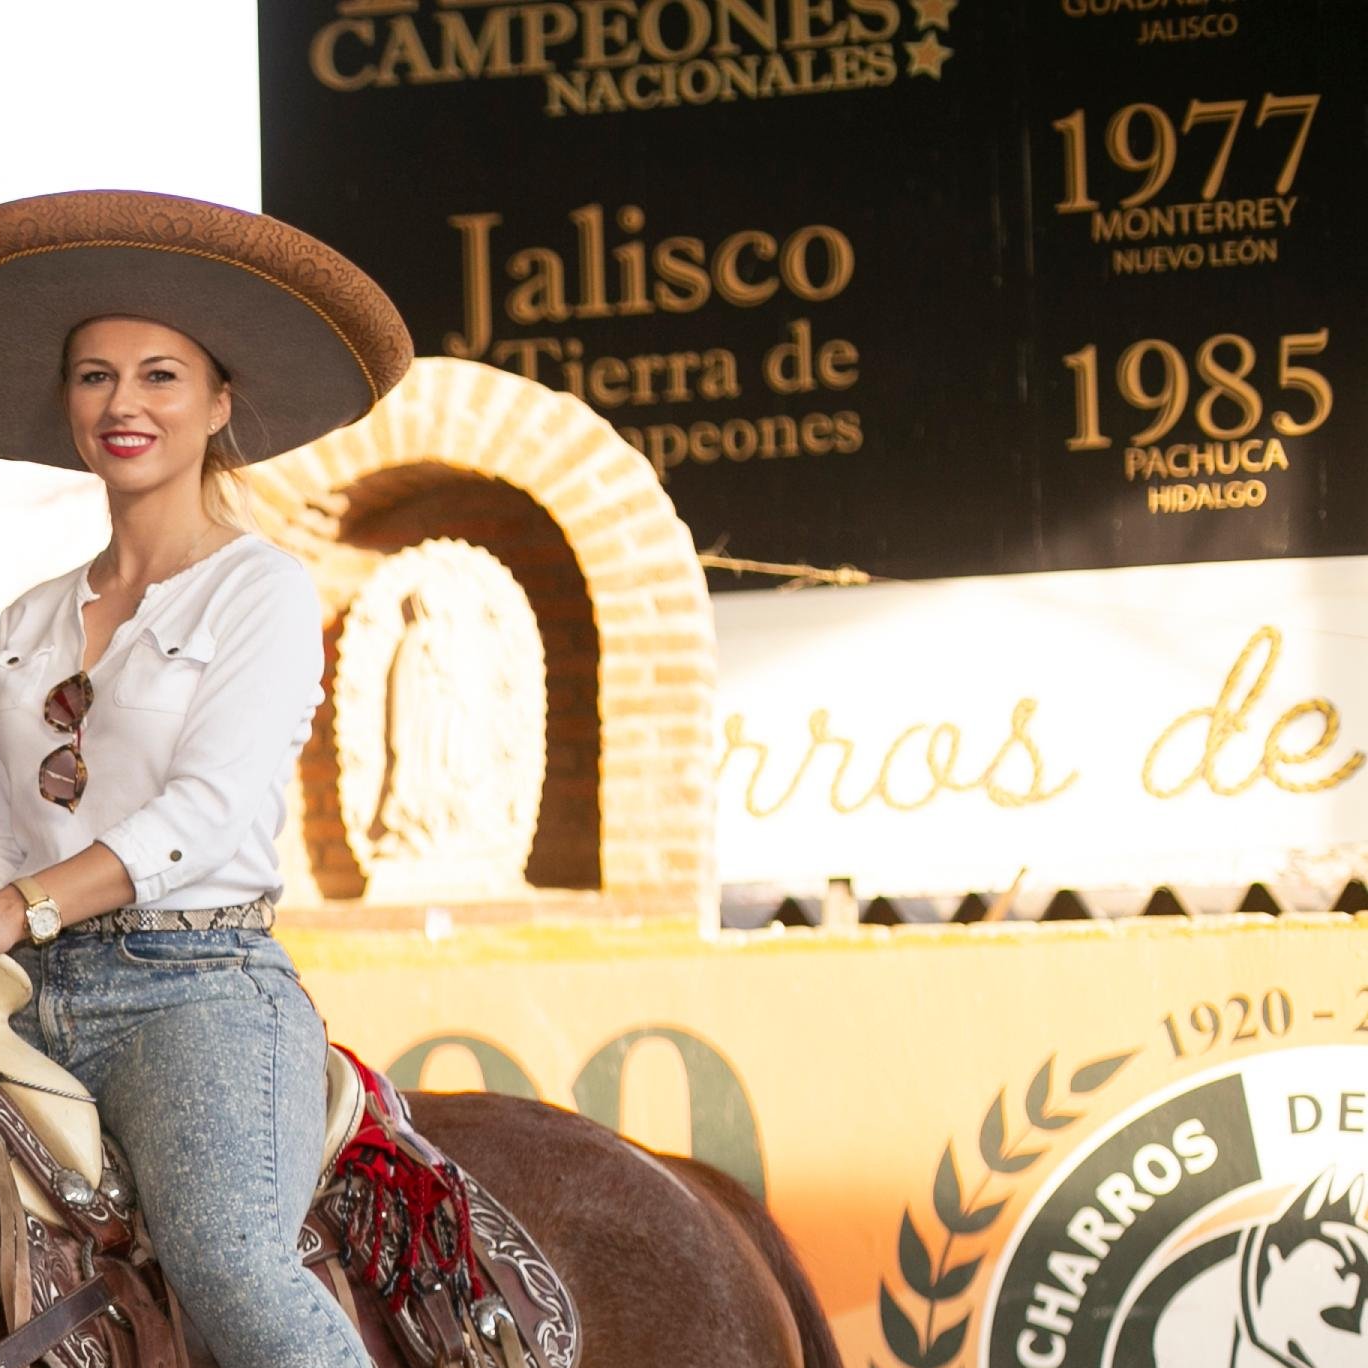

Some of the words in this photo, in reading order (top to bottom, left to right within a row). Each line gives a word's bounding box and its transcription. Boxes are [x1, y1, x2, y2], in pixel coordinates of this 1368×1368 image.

[310, 0, 901, 91] CAMPEONES
[1136, 12, 1240, 46] JALISCO
[544, 42, 899, 117] NACIONALES
[1053, 93, 1322, 214] 1977
[1090, 196, 1299, 244] MONTERREY
[1112, 243, 1206, 274] NUEVO
[1208, 237, 1280, 268] LEÓN
[442, 203, 856, 359] Jalisco
[493, 337, 742, 408] Tierra
[766, 320, 861, 393] de
[1064, 327, 1334, 451] 1985
[1124, 438, 1290, 481] PACHUCA
[1148, 479, 1268, 514] HIDALGO
[1141, 624, 1368, 798] de
[1160, 986, 1296, 1059] 1920
[1287, 1092, 1367, 1135] DE
